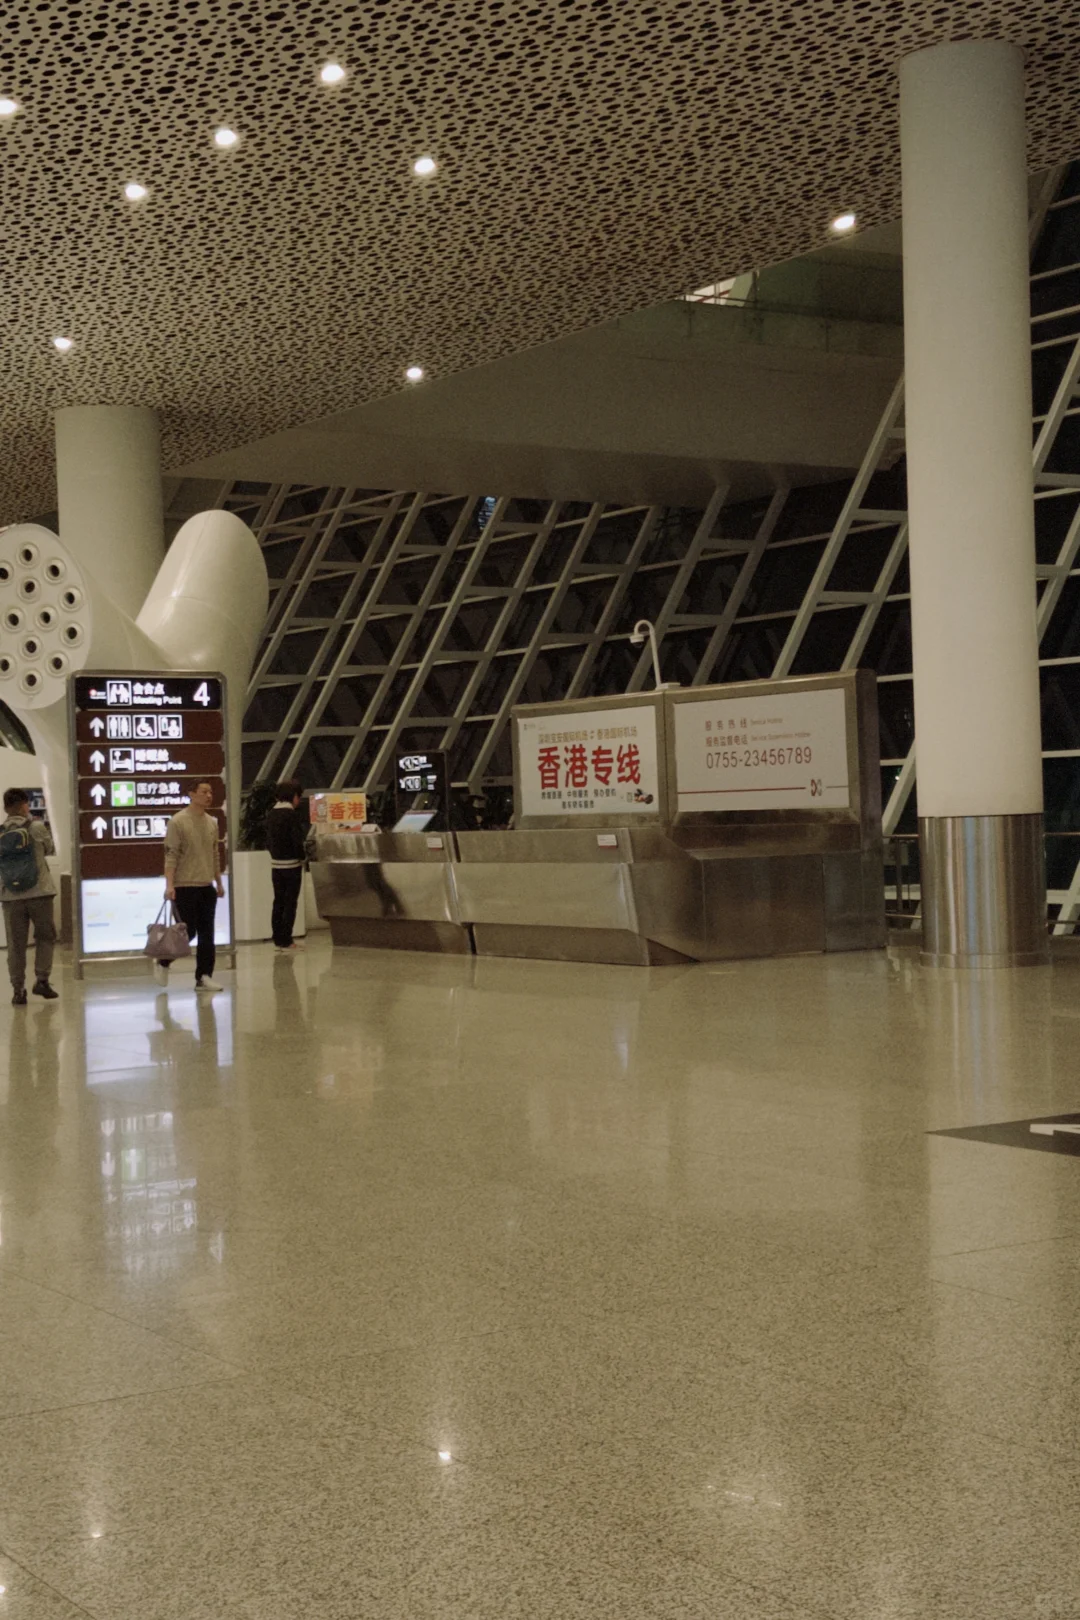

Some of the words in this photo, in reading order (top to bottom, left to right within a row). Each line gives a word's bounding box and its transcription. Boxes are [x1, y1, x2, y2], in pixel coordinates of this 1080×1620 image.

[163, 696, 182, 705] Point
[193, 682, 211, 707] 4
[538, 744, 641, 789] 香港专线
[706, 746, 812, 769] 0755-23456789
[137, 782, 180, 795] 医疗急救
[137, 797, 165, 805] Medical
[329, 802, 365, 820] 香港
